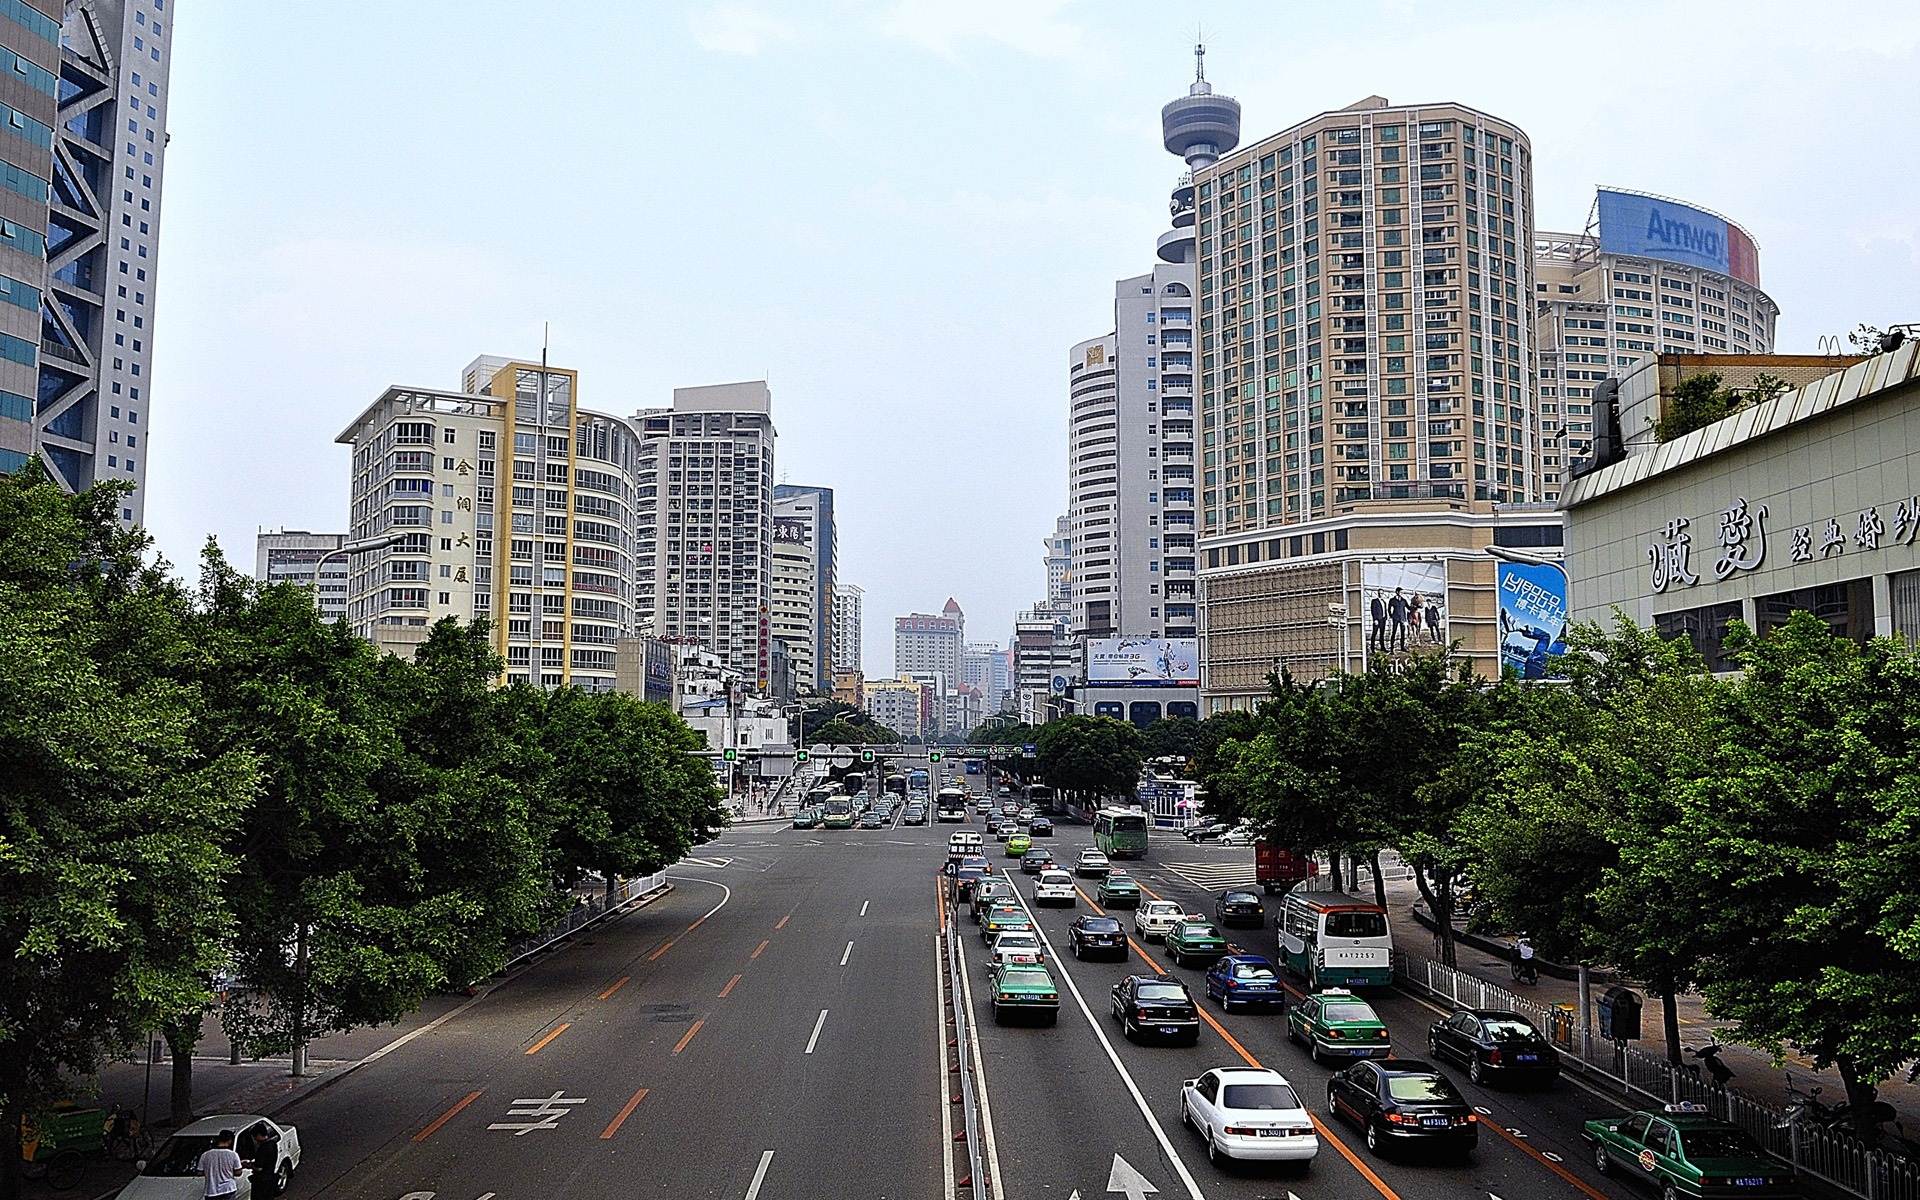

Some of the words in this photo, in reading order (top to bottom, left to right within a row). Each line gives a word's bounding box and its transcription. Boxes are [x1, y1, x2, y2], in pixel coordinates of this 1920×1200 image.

[1647, 208, 1725, 265] Amway
[453, 459, 474, 583] 金润大厦
[1520, 588, 1566, 619] YOUTH
[1521, 580, 1561, 606] BOCO
